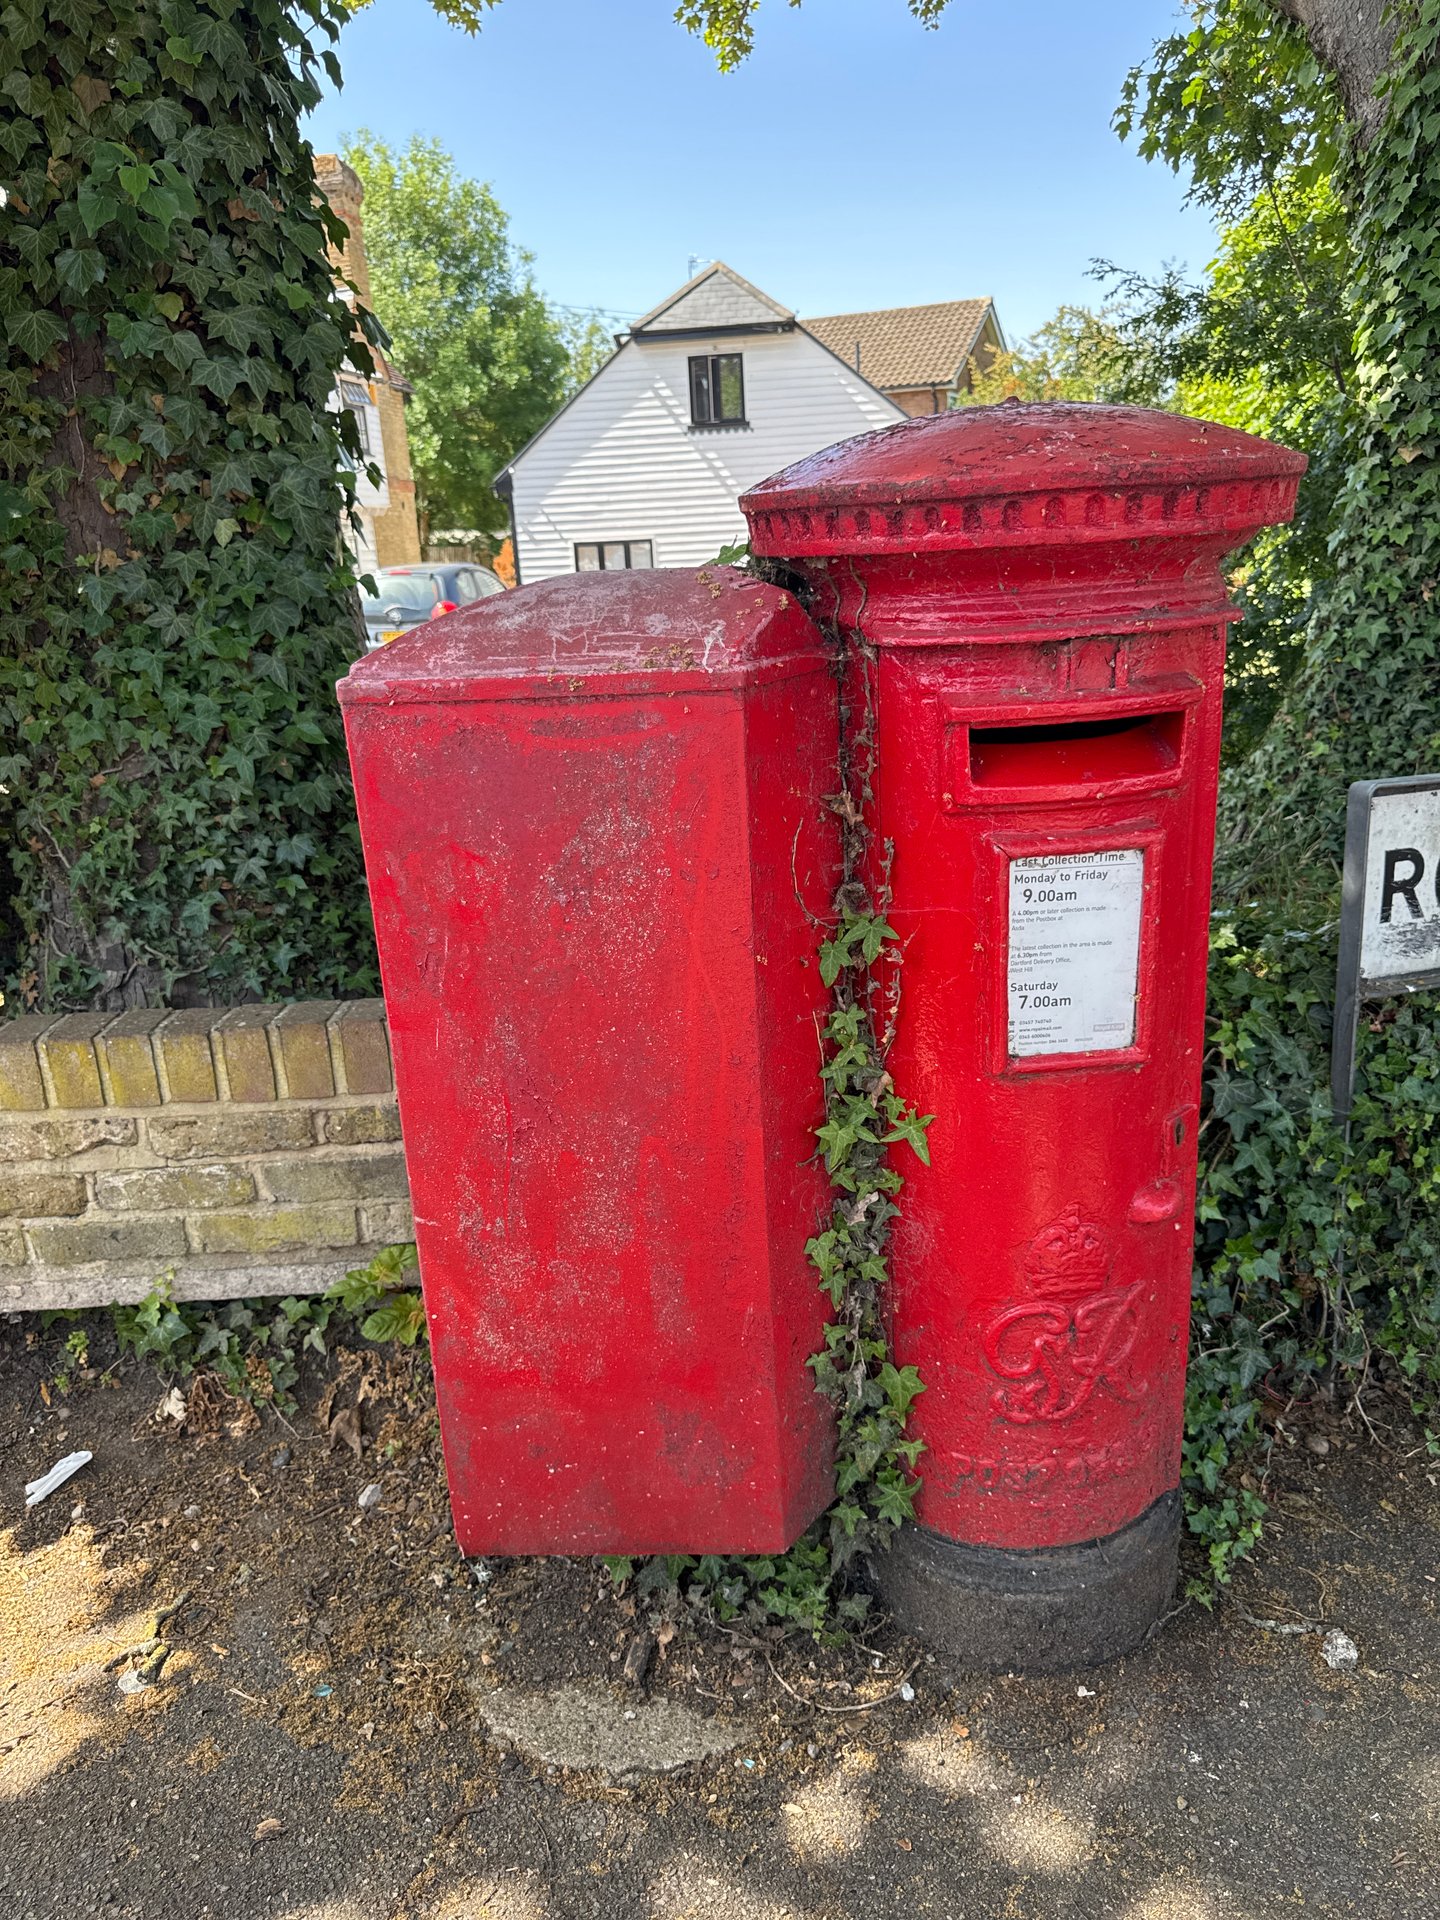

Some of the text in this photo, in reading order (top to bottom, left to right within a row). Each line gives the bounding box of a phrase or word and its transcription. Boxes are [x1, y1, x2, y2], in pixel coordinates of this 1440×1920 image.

[1015, 852, 1126, 868] Last Collection Time
[1014, 870, 1109, 884] Monday to Friday
[1379, 846, 1440, 924] R
[1023, 888, 1077, 904] 9.00am
[1033, 958, 1054, 966] Delivery
[1010, 981, 1059, 993] Saturday
[1018, 995, 1072, 1010] 7.00am
